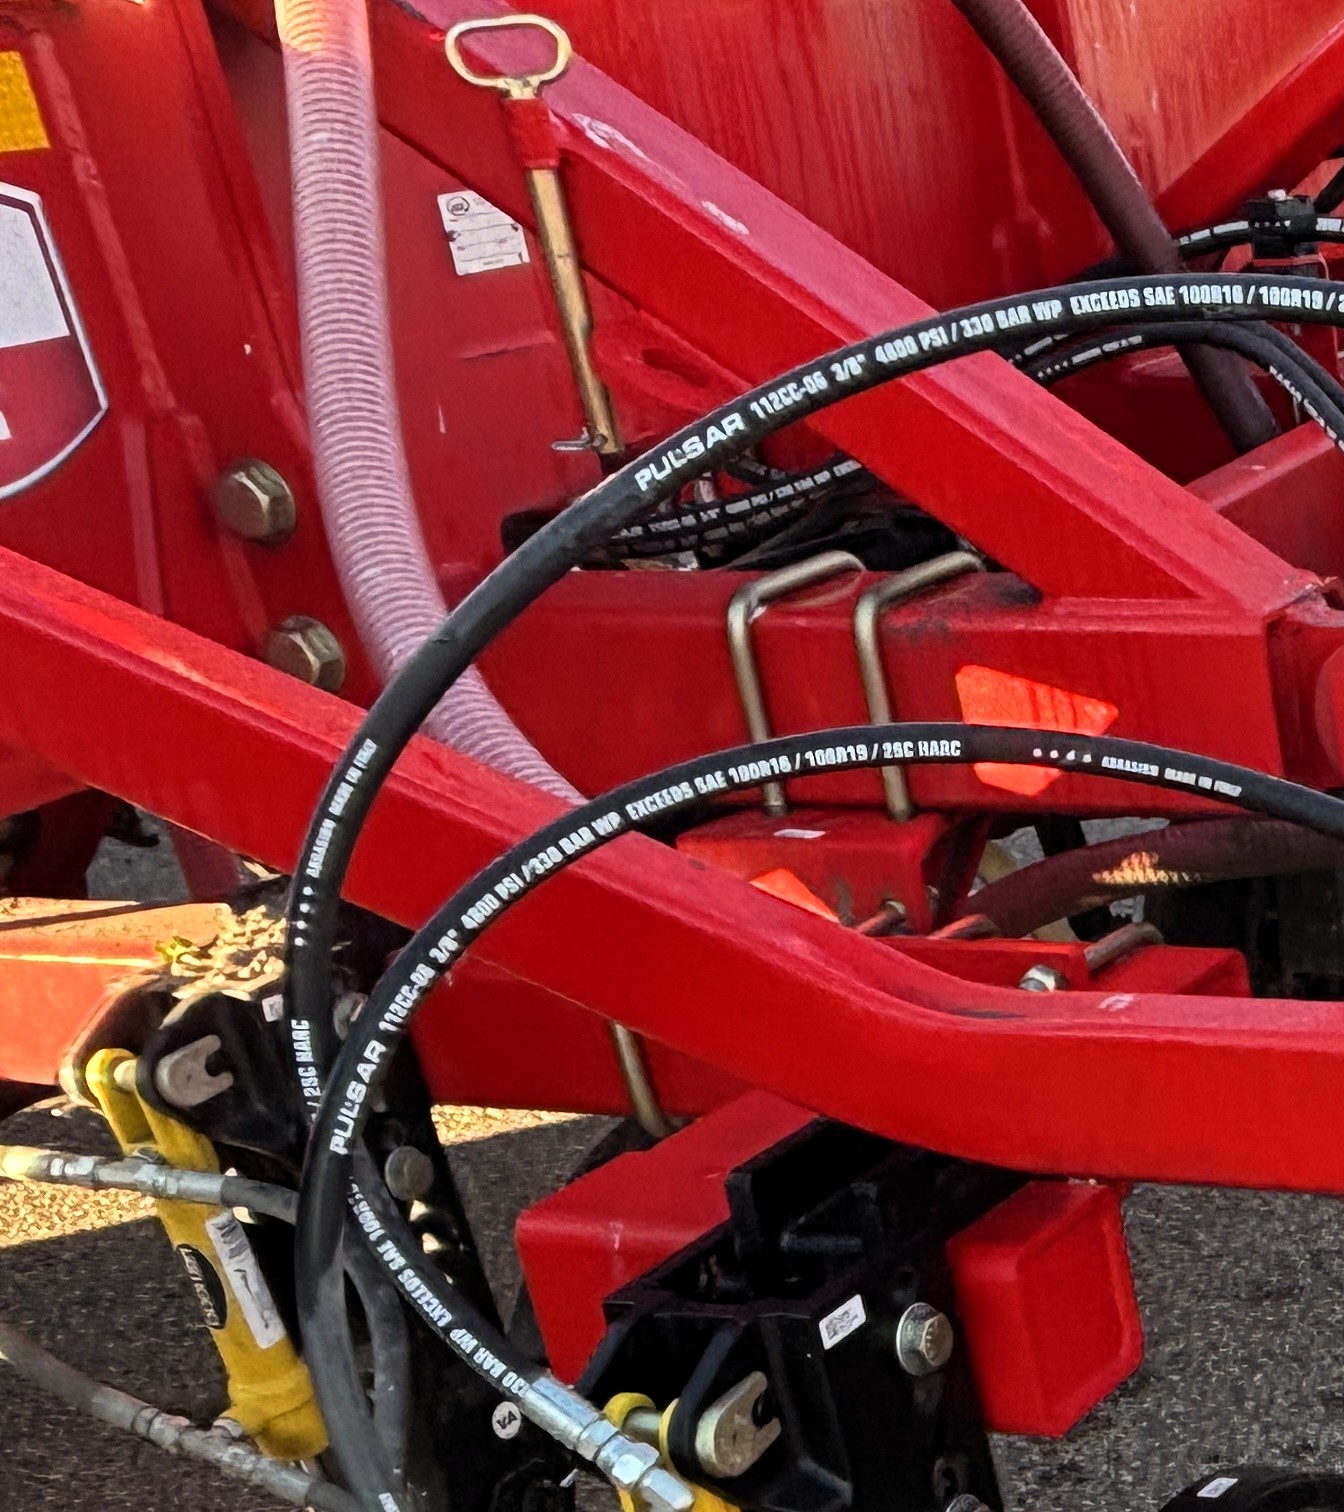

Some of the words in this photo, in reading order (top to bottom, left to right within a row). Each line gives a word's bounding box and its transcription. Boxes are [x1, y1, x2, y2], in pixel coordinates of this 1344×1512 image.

[634, 412, 746, 492] PULSAR
[917, 326, 949, 351] PSI
[959, 313, 995, 338] 330
[995, 305, 1032, 330] BAR
[1032, 299, 1063, 321] WP
[1069, 288, 1141, 316] EXCEEDS
[1142, 286, 1176, 306] SAE
[329, 1039, 387, 1156] PULSAR
[493, 872, 525, 900] PSI
[558, 826, 596, 855] BAR
[591, 811, 622, 836] WP
[625, 781, 695, 821] EXCEEDS
[694, 770, 728, 794] SAE
[376, 1239, 407, 1271] SAE
[397, 1268, 453, 1327] EXCEEDS
[449, 1328, 479, 1354] WP
[472, 1347, 507, 1379] BAR
